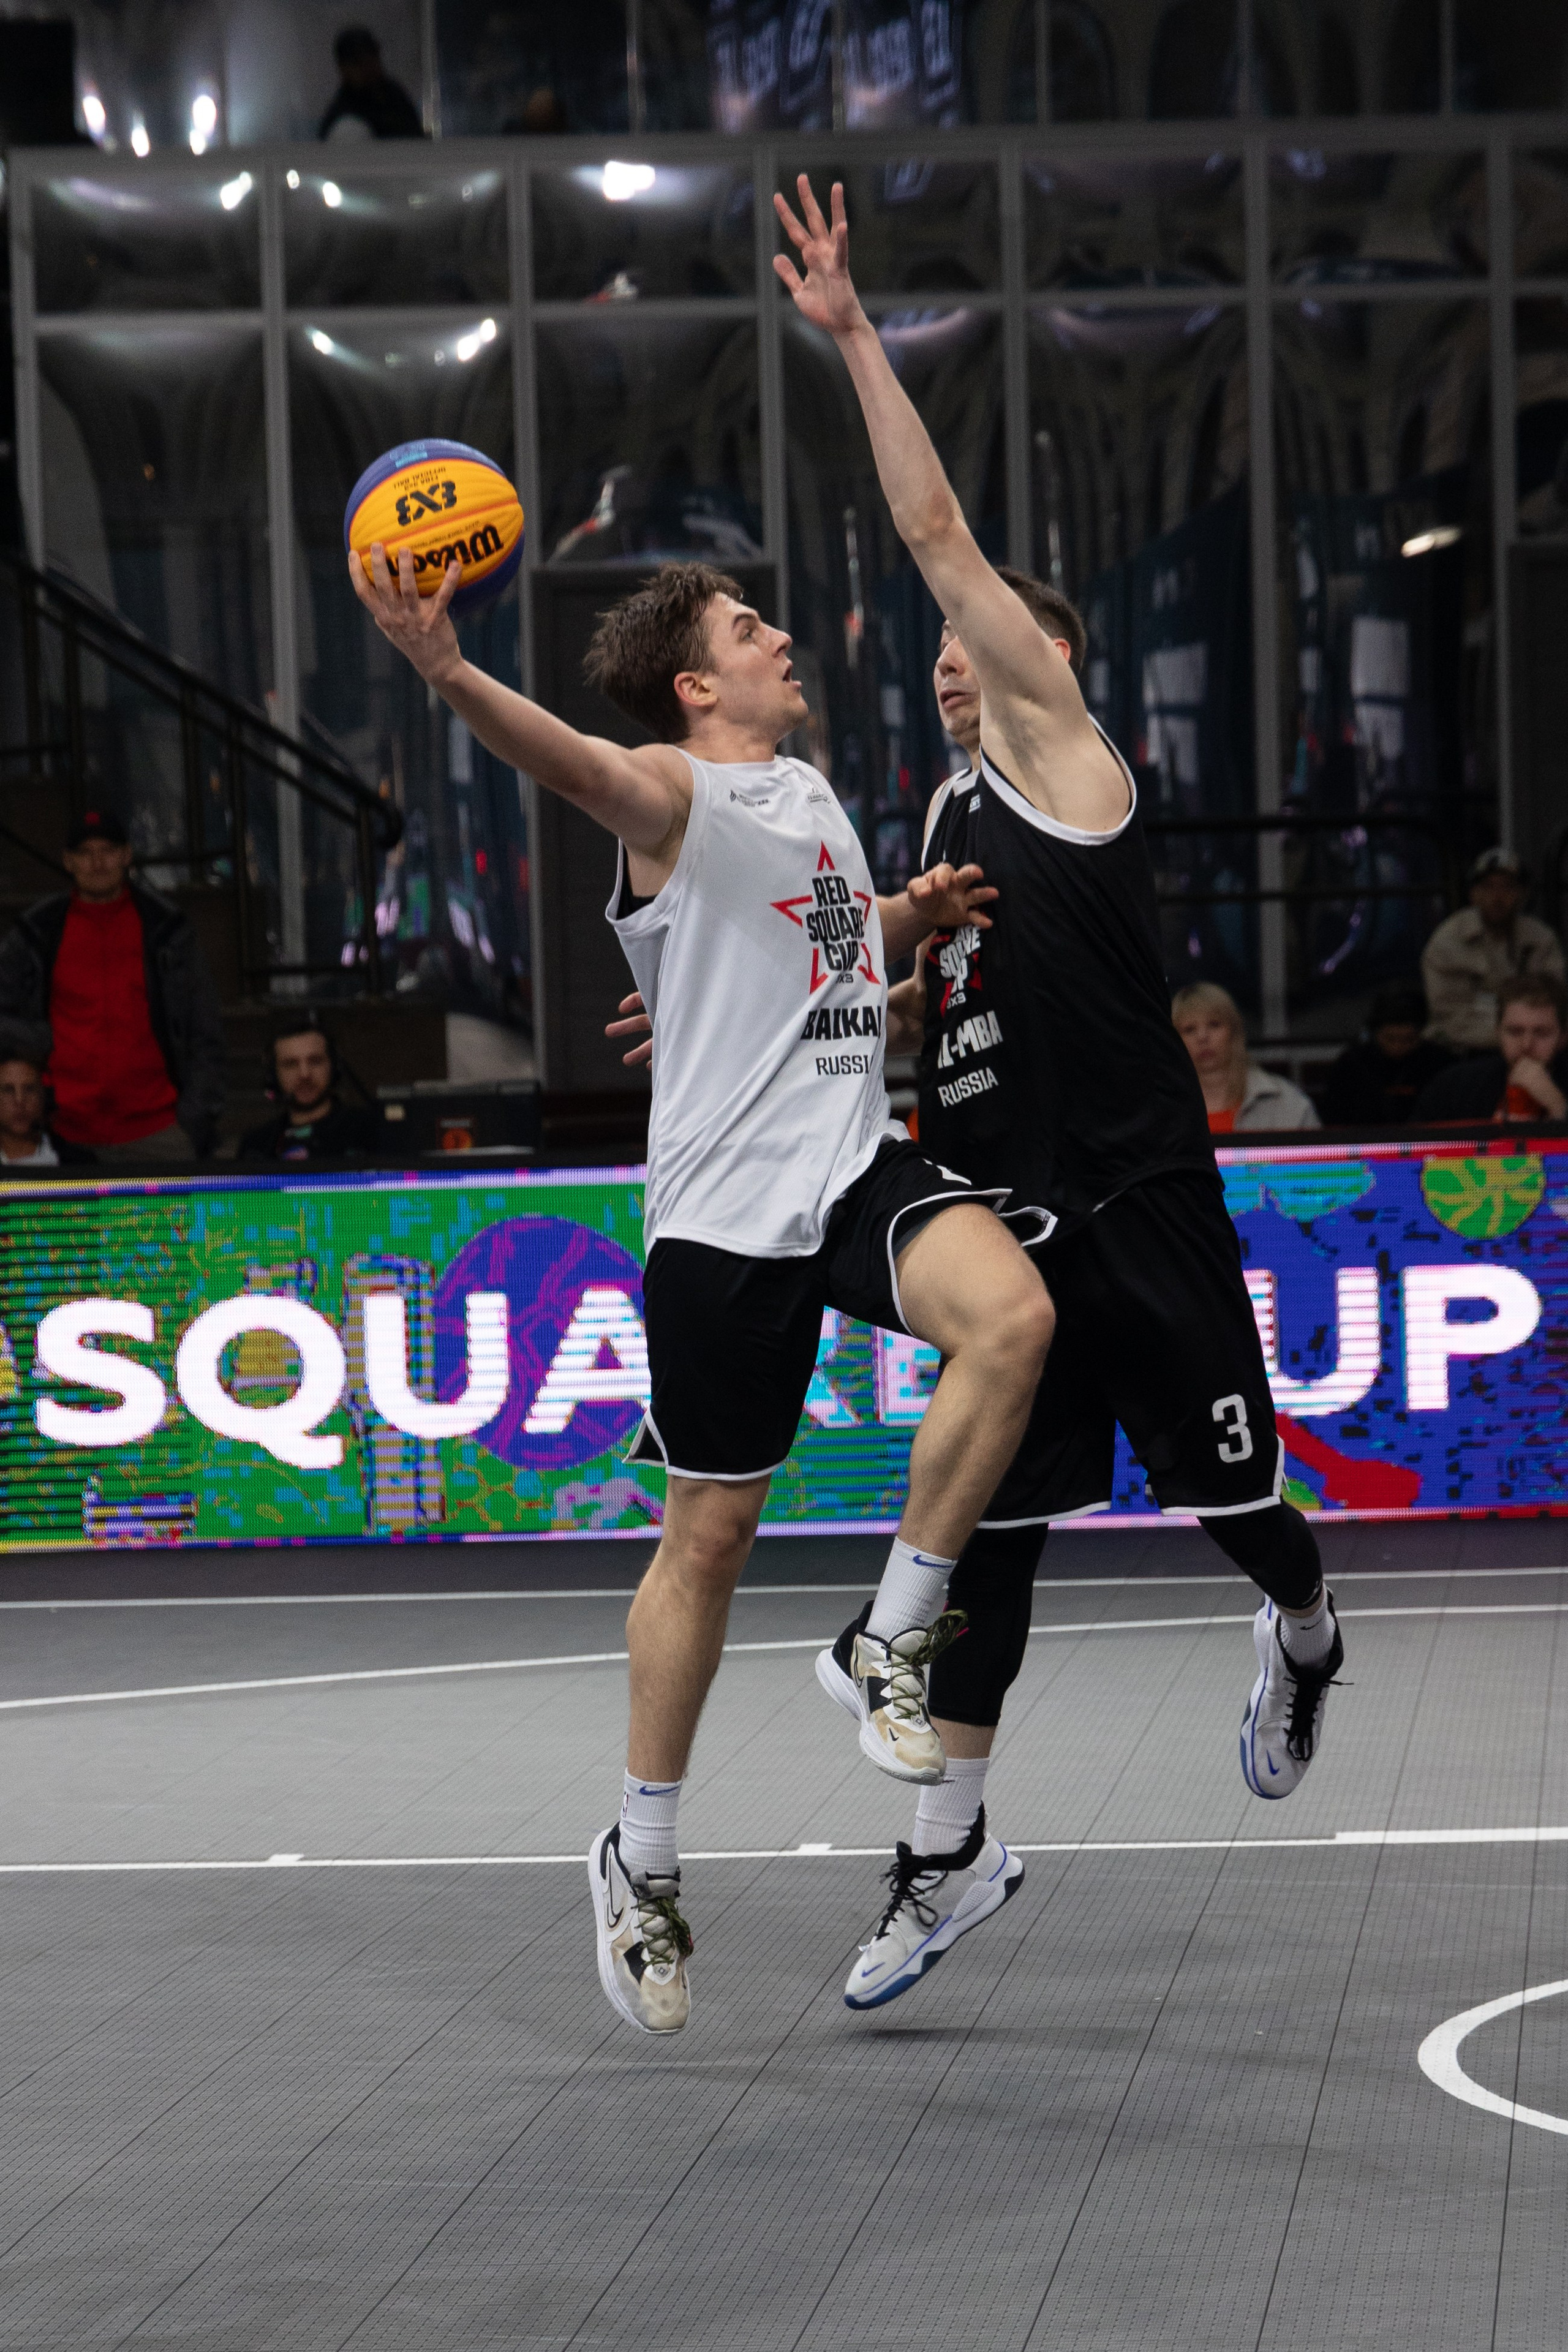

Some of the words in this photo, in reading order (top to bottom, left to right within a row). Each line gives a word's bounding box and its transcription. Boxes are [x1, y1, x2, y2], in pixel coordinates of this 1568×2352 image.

[386, 523, 504, 576] Wilson
[812, 875, 851, 908] RED
[806, 906, 865, 942] SQUARE
[823, 940, 859, 971] CUP
[815, 1054, 874, 1076] RUSSI
[937, 1066, 999, 1108] RUSSIA
[1211, 1393, 1254, 1464] 3
